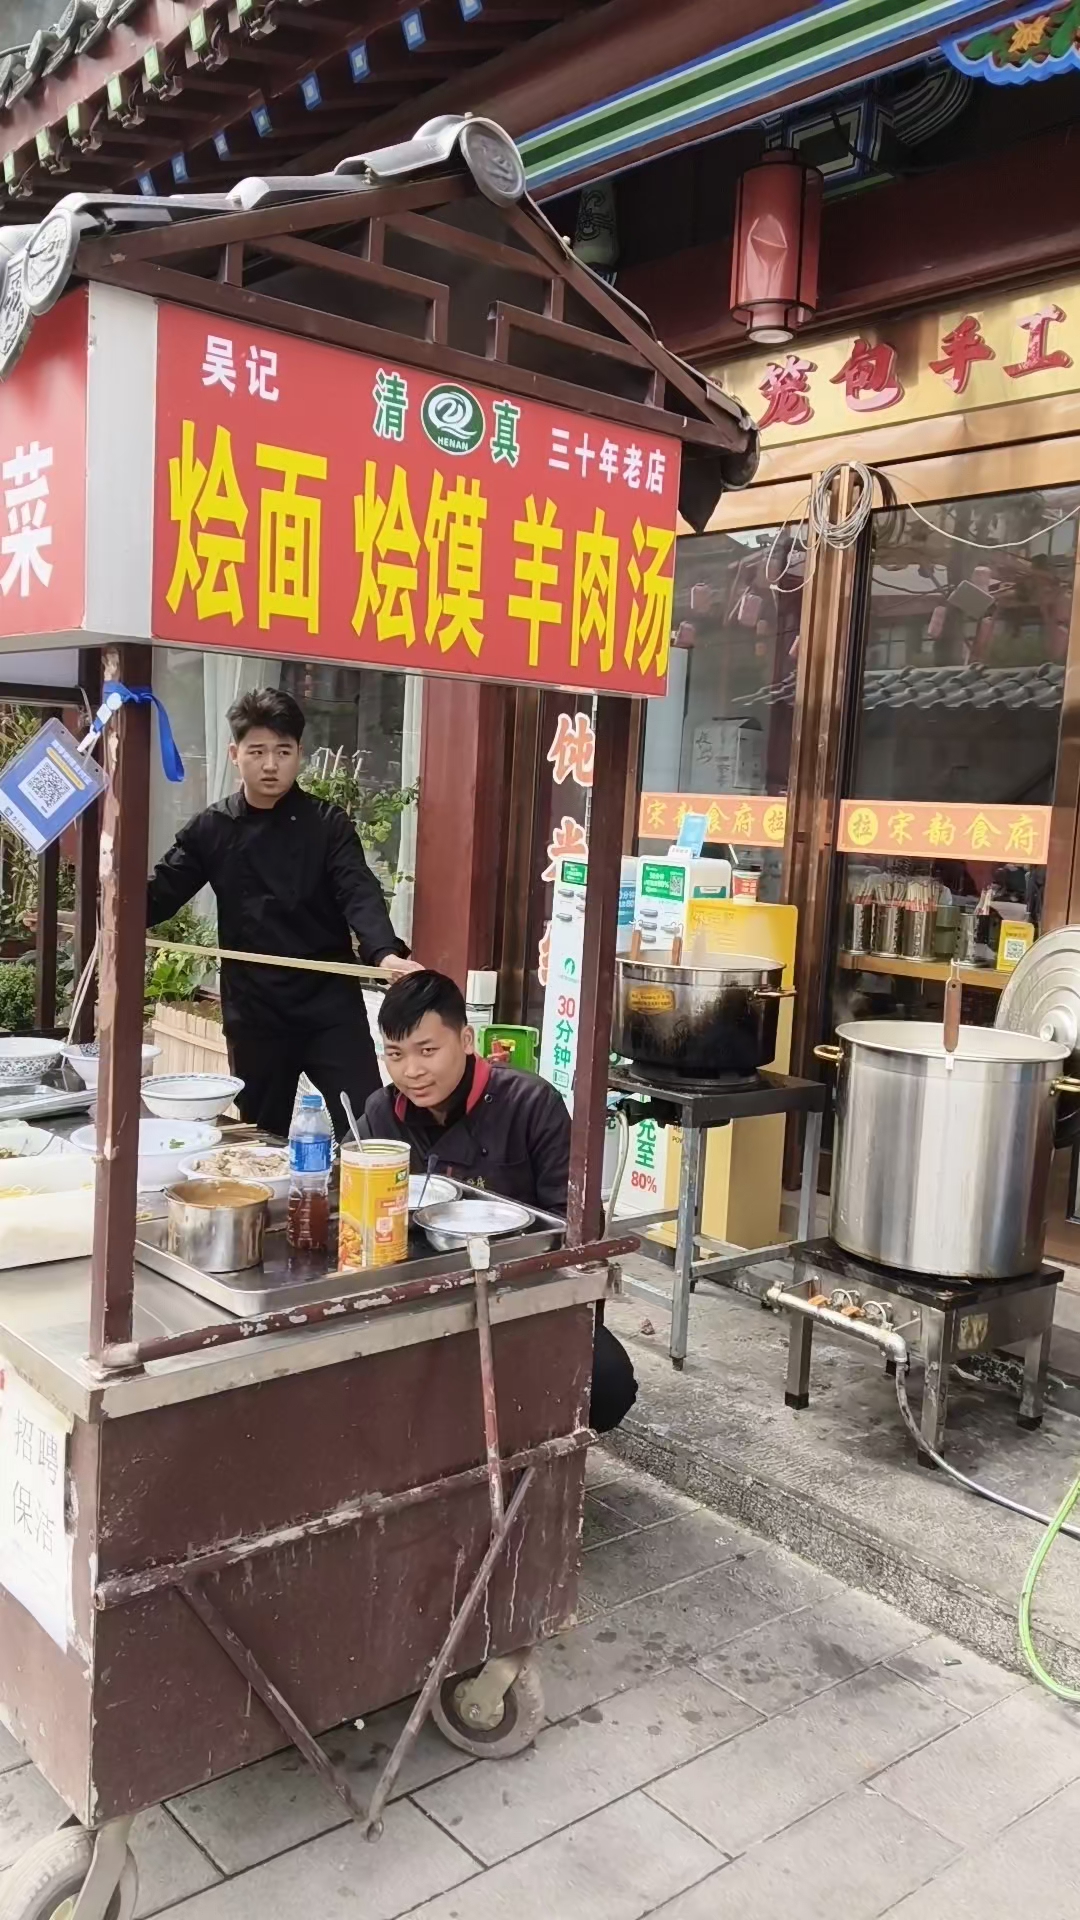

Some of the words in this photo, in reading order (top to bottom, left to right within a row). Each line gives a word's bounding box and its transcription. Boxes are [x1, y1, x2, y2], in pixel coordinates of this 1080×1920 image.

[203, 336, 279, 402] 吴记
[373, 368, 408, 441] 清
[490, 400, 520, 467] 真
[437, 436, 469, 450] HENAN
[549, 428, 666, 494] 三十年老店
[0, 440, 54, 597] 菜
[167, 420, 328, 634] 烩面
[352, 460, 487, 656] 烩馍
[508, 494, 676, 677] 羊肉汤
[553, 994, 576, 1069] 30分钟
[14, 1408, 60, 1486] 招聘
[12, 1480, 56, 1556] 保洁
